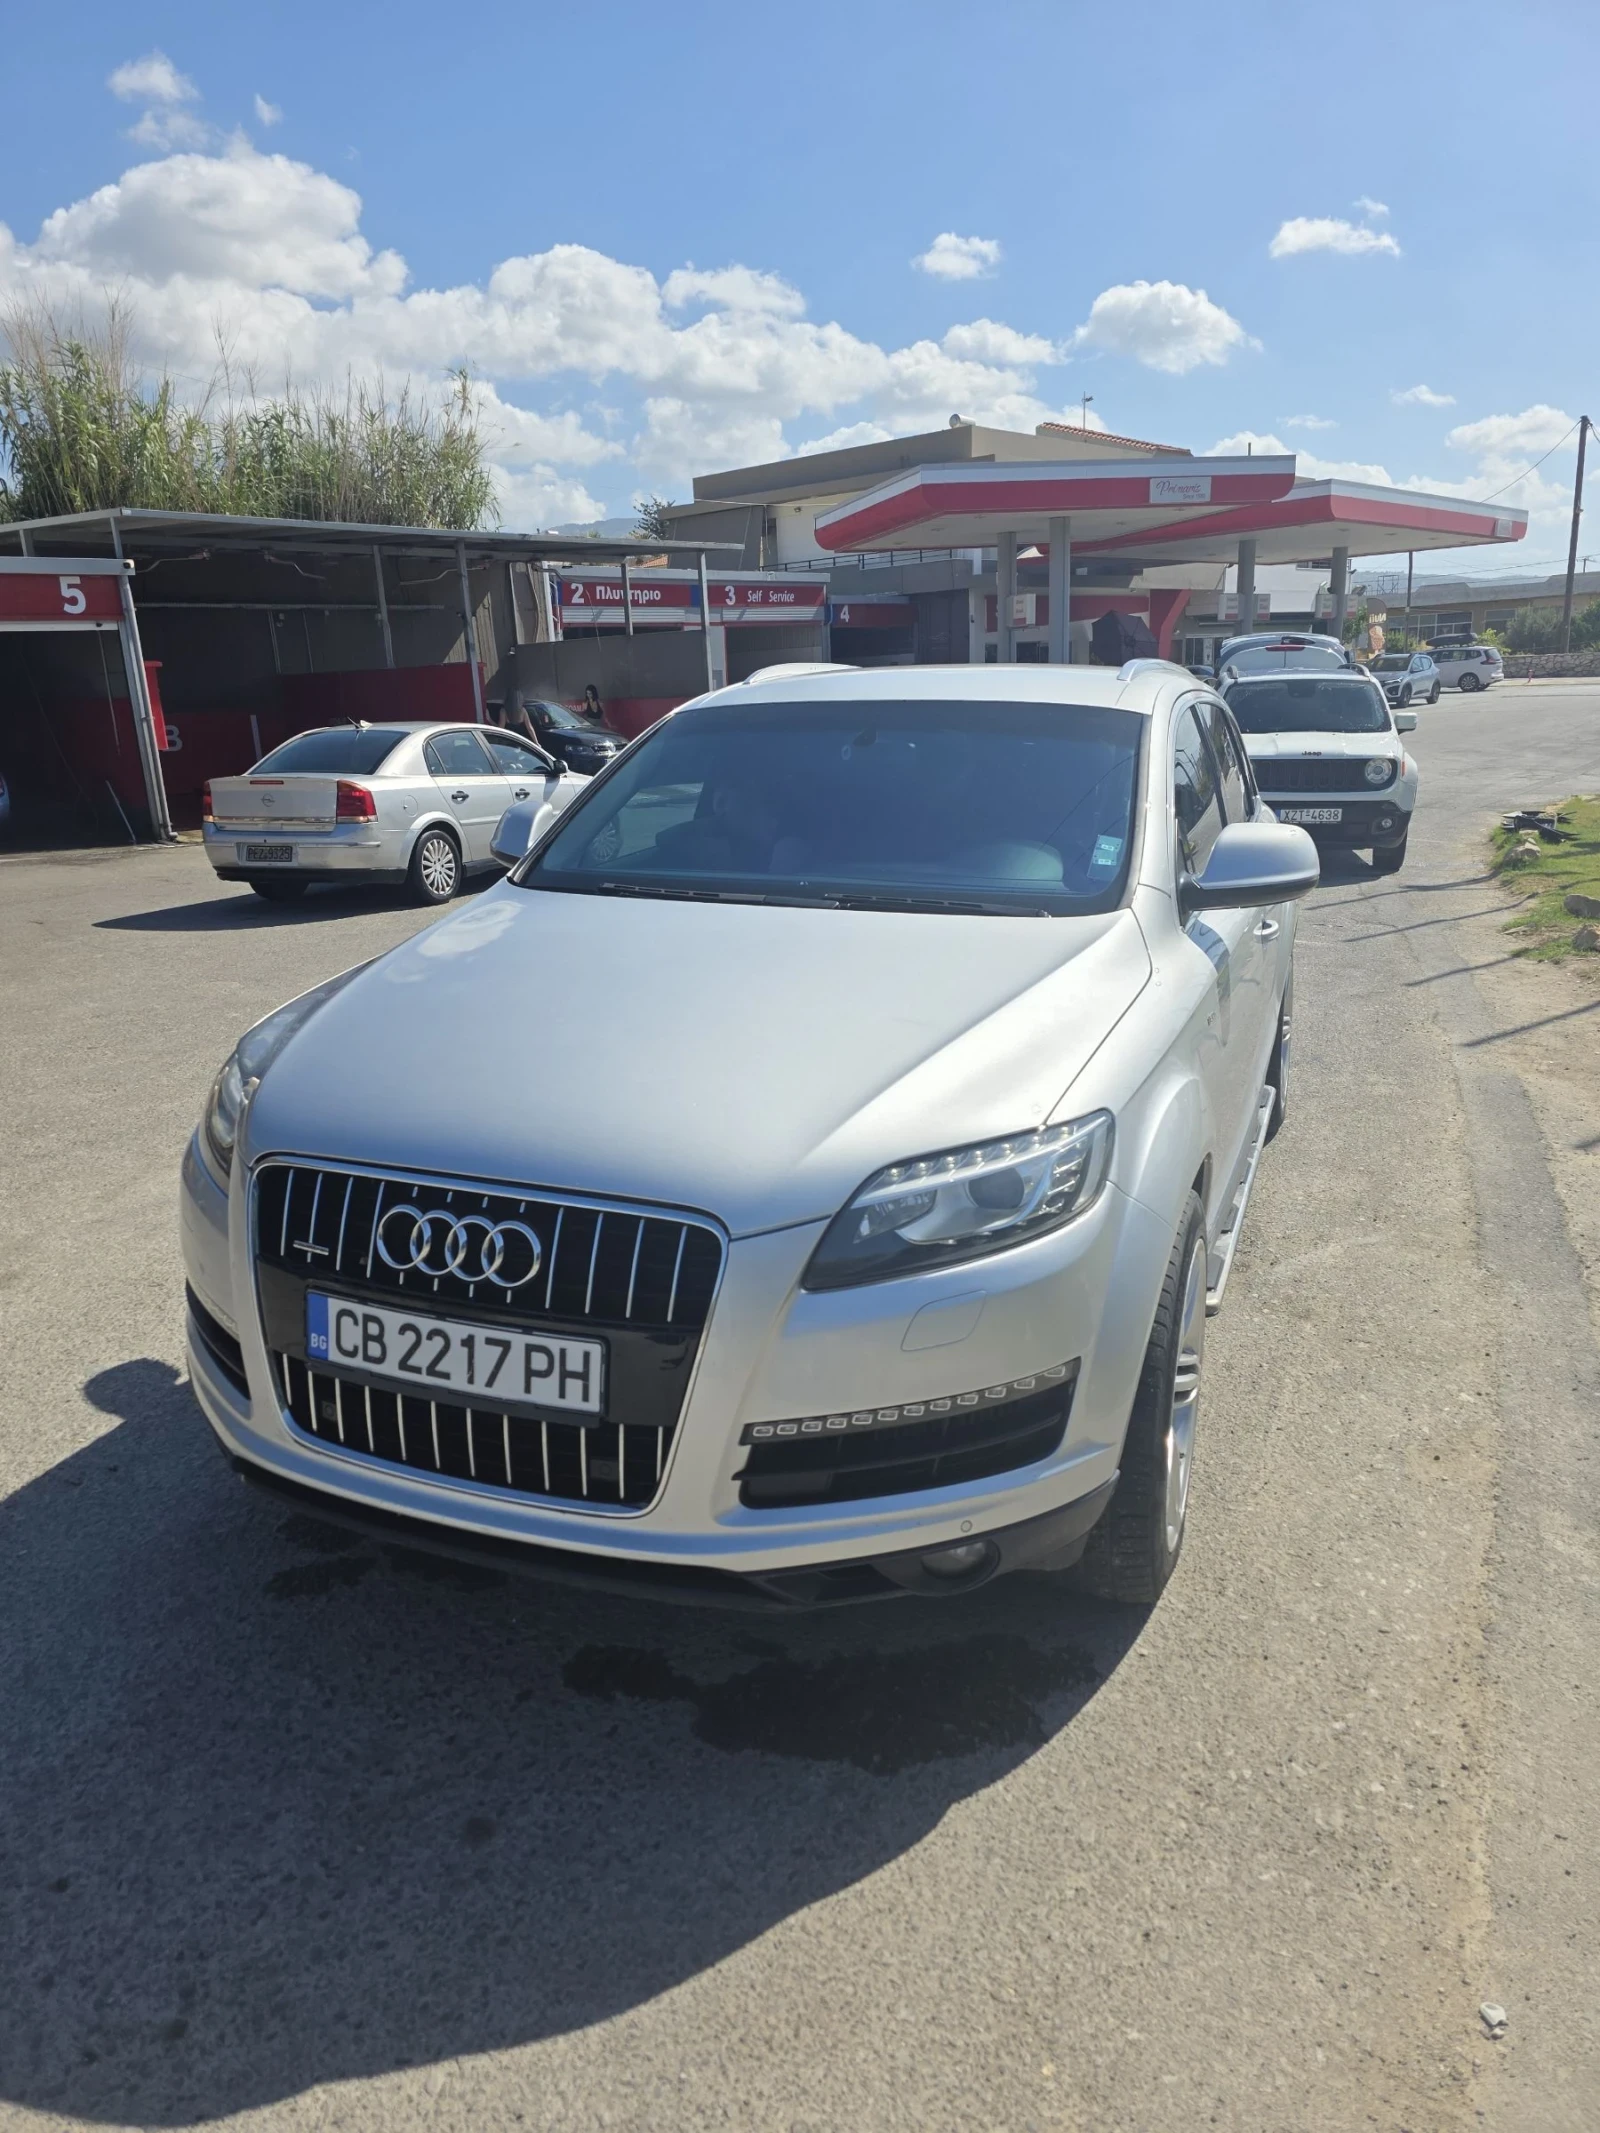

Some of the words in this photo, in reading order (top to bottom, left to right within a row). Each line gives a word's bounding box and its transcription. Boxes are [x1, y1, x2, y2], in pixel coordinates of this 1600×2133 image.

[59, 576, 87, 614] 5
[570, 583, 585, 604] 2
[725, 586, 736, 605] 3
[747, 590, 762, 602] Self
[769, 590, 795, 602] Service
[840, 605, 850, 623] 4
[310, 1333, 327, 1350] BG
[335, 1308, 387, 1365] CB
[398, 1323, 512, 1388] 2217
[524, 1343, 591, 1402] PH
